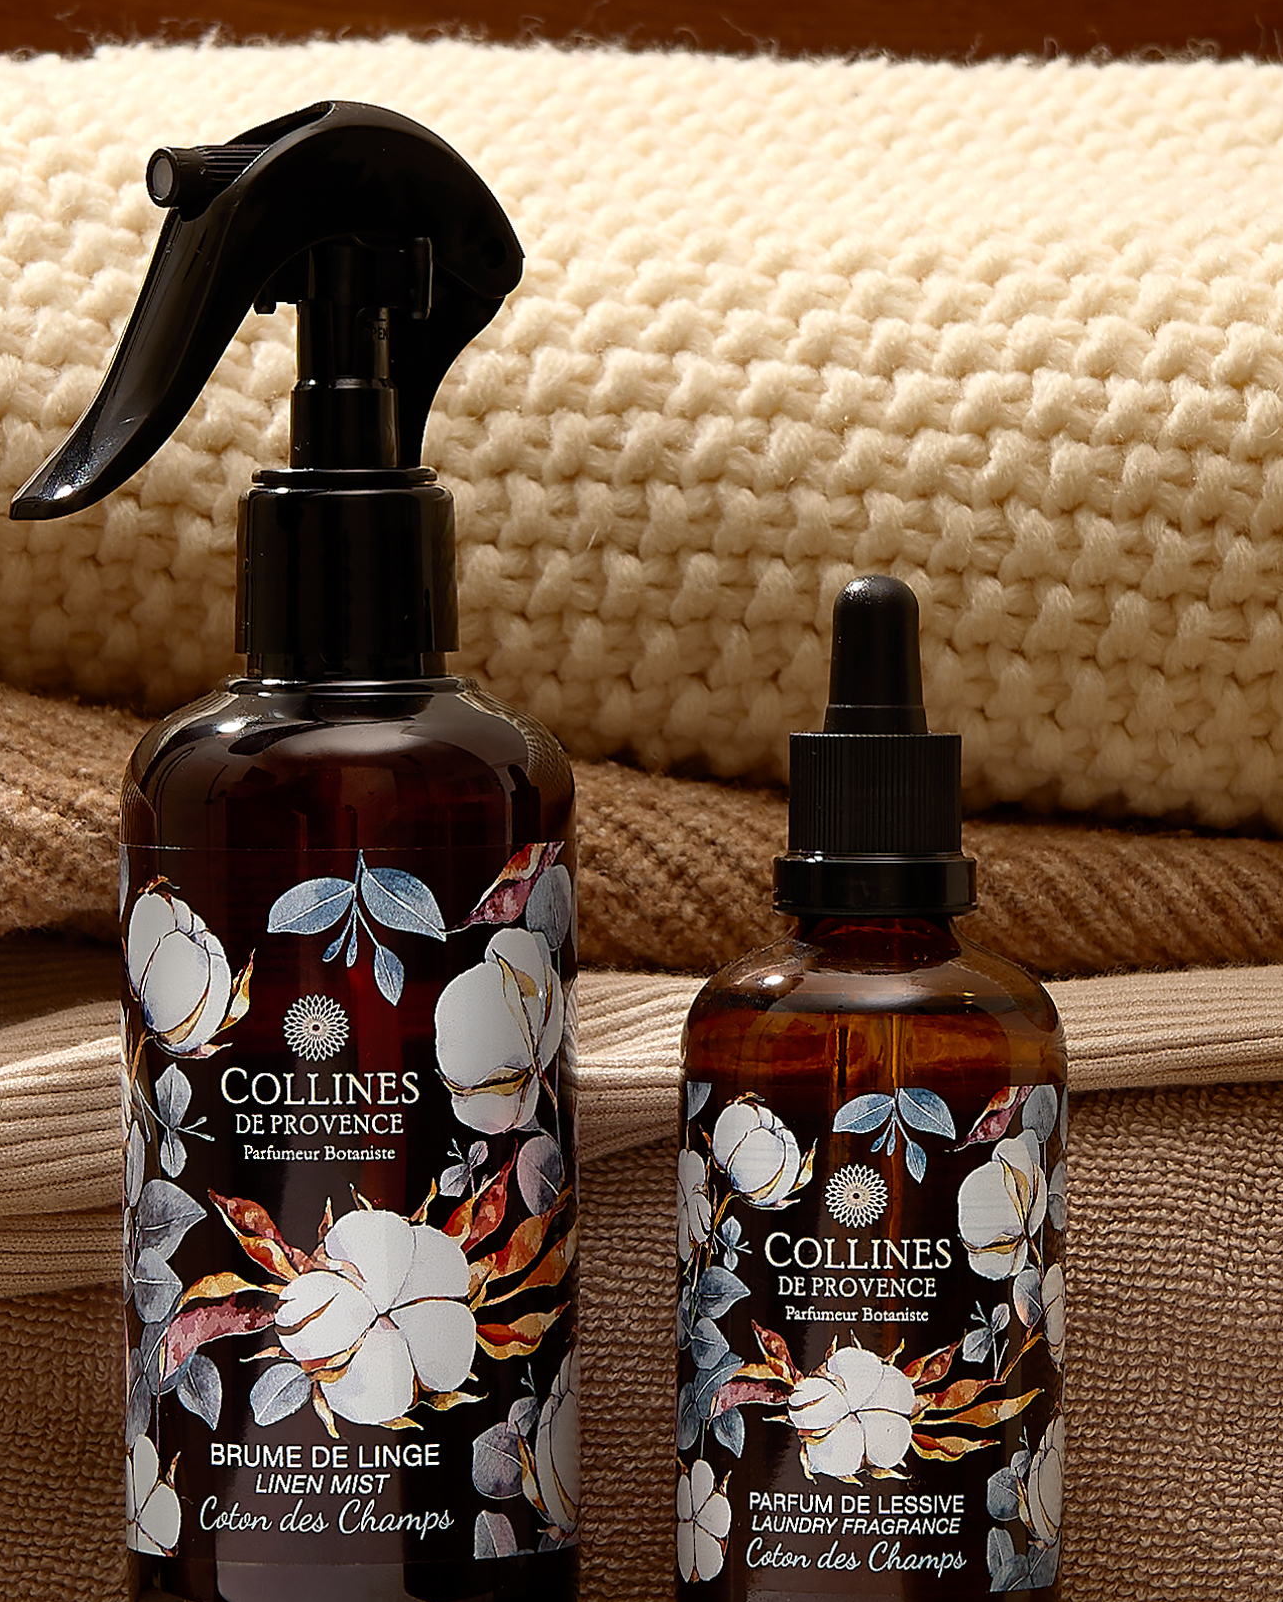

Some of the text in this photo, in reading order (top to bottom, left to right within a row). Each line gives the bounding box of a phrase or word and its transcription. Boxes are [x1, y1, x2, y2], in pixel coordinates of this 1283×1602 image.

[220, 1067, 420, 1105] COLLINES
[235, 1113, 404, 1135] DE PROVENCE
[243, 1144, 396, 1161] Parfumeur Botaniste
[764, 1231, 952, 1270] COLLINES
[777, 1275, 937, 1298] DE PROVENCE
[784, 1305, 929, 1322] Parfumeur Botaniste
[210, 1442, 440, 1469] BRUME DE LINGE
[255, 1473, 391, 1495] LINEN MIST
[749, 1491, 965, 1515] PARFUM DE LESSIVE
[199, 1496, 455, 1541] Coton des Champs
[751, 1514, 960, 1536] LAUNDRY FRAGRANCE
[746, 1536, 967, 1578] Coton des Champs
